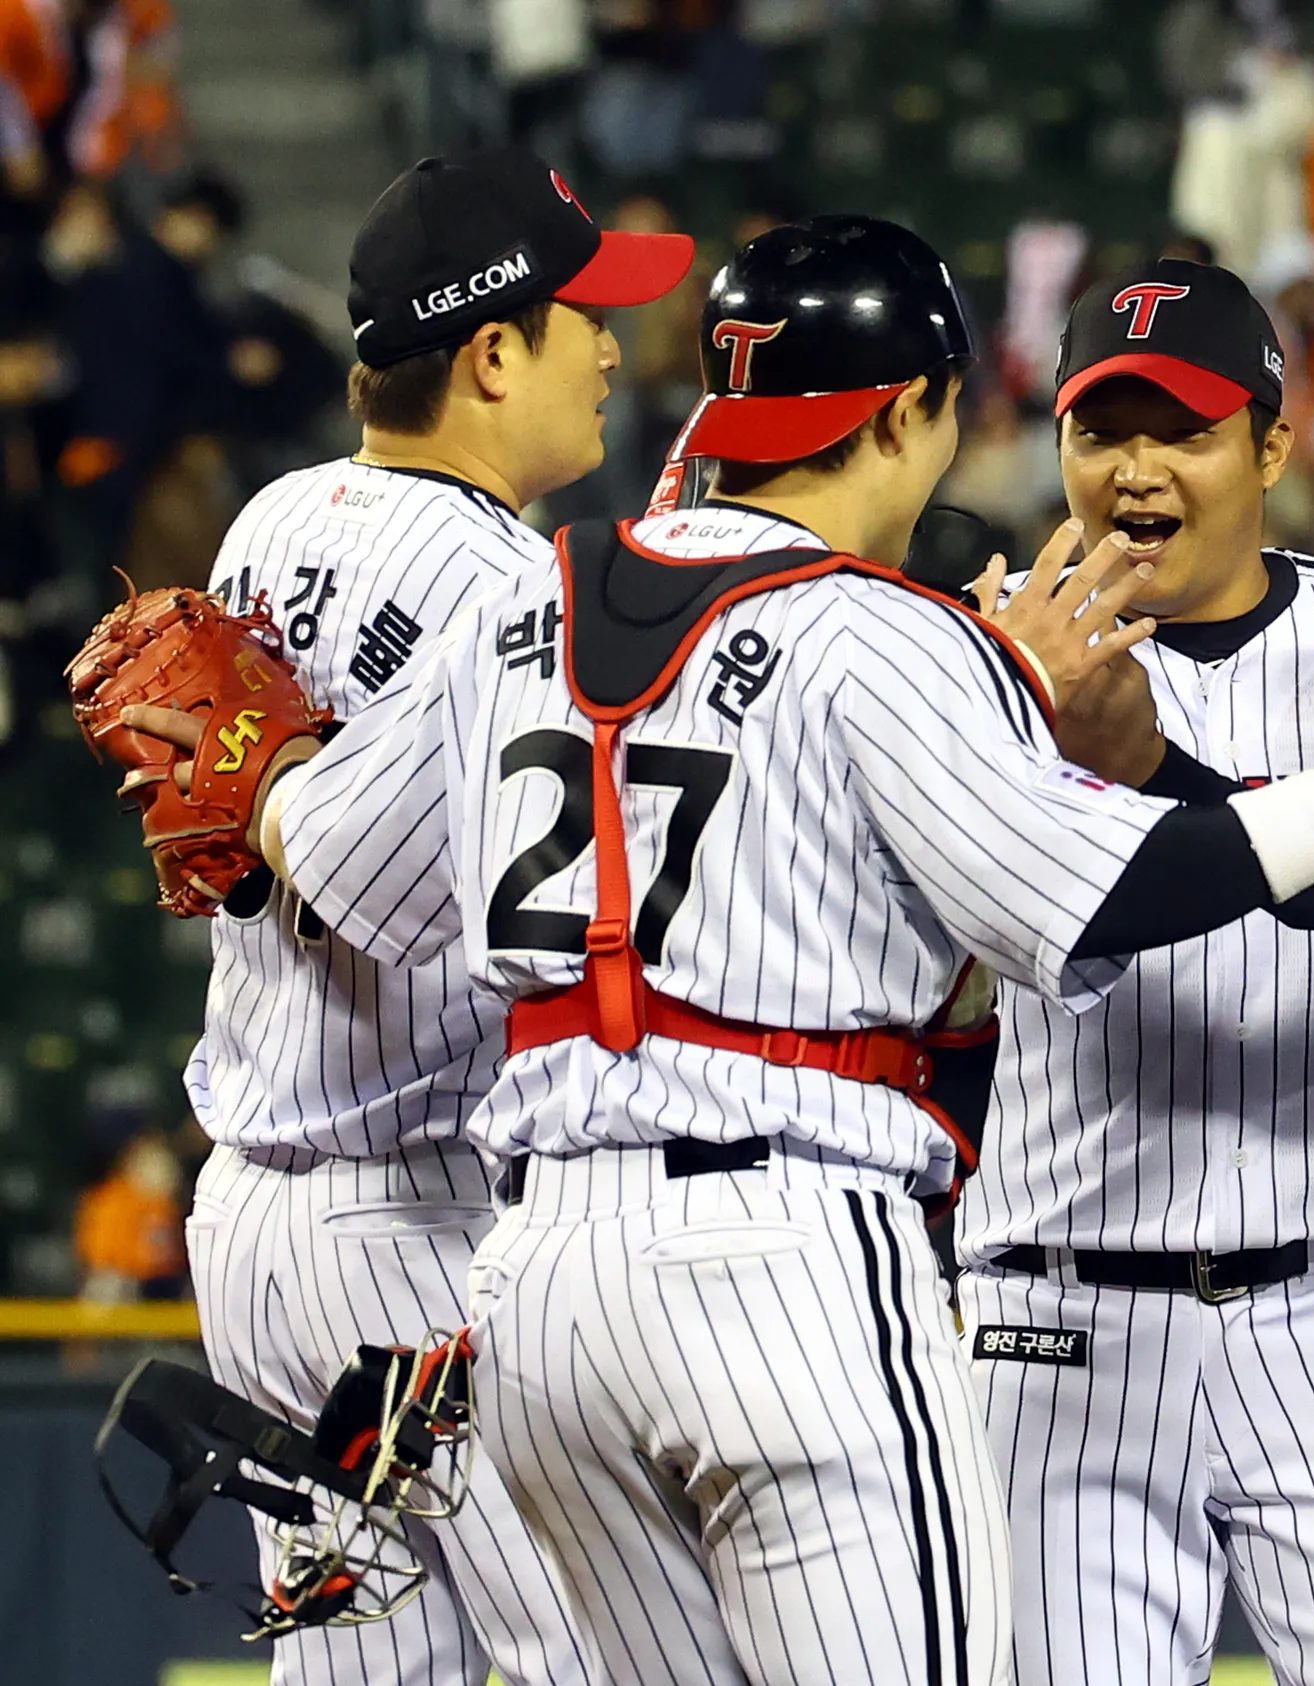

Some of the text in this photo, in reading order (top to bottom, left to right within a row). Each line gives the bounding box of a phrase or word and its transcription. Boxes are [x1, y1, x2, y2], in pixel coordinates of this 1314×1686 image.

[410, 251, 532, 321] LGE.COM
[1111, 282, 1191, 339] T
[712, 318, 788, 392] T
[486, 724, 738, 968] 27
[982, 1330, 1077, 1358] 영진 구론산
